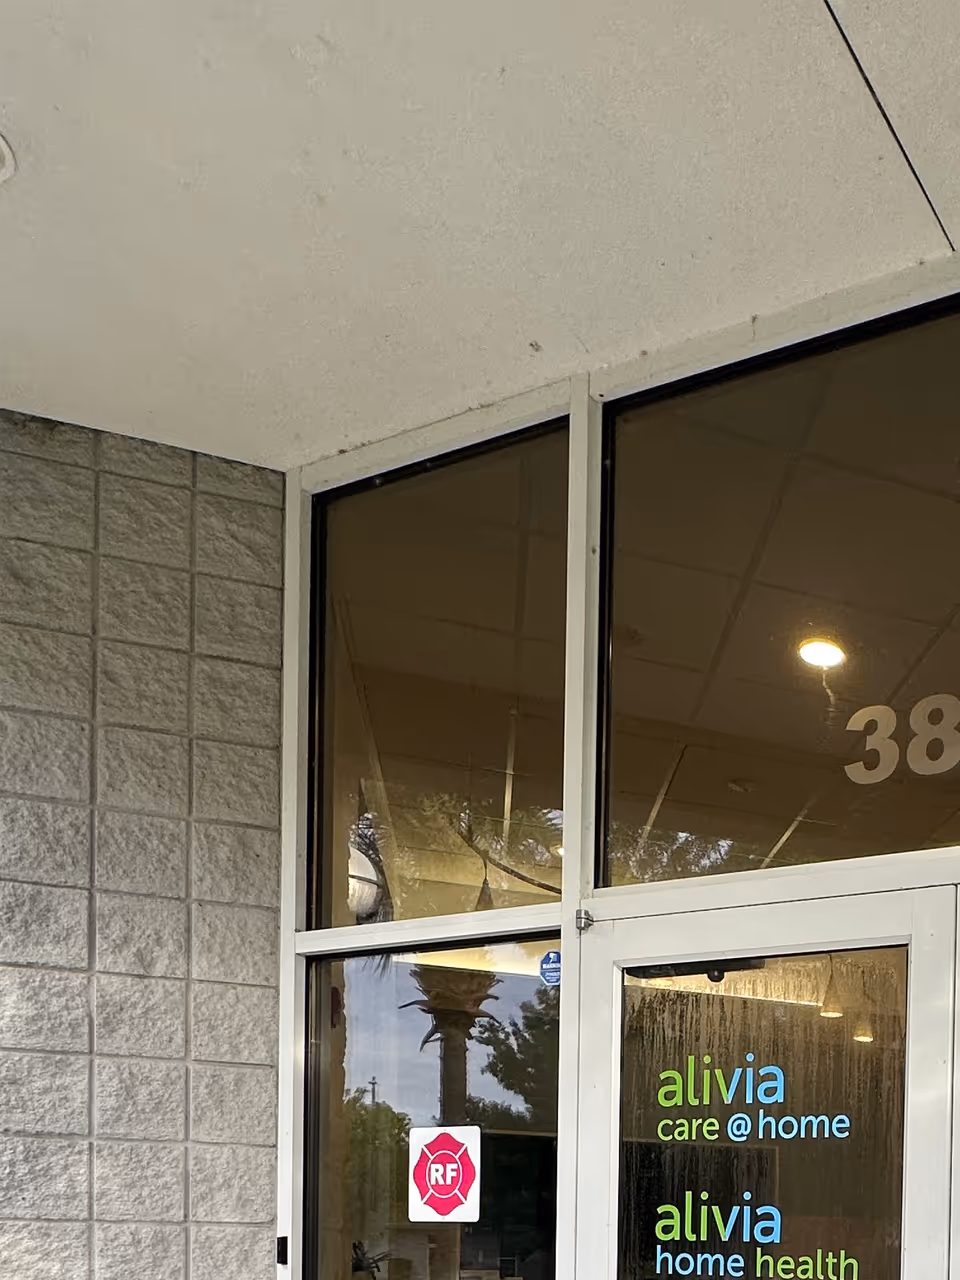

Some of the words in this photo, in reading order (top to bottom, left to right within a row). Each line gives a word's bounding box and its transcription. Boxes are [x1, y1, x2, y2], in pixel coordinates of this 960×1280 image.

[657, 1053, 785, 1108] alivia
[657, 1116, 719, 1141] care
[726, 1112, 752, 1142] @
[758, 1109, 850, 1139] home
[430, 1163, 458, 1186] RF
[655, 1190, 782, 1244] alivia
[655, 1245, 745, 1277] home
